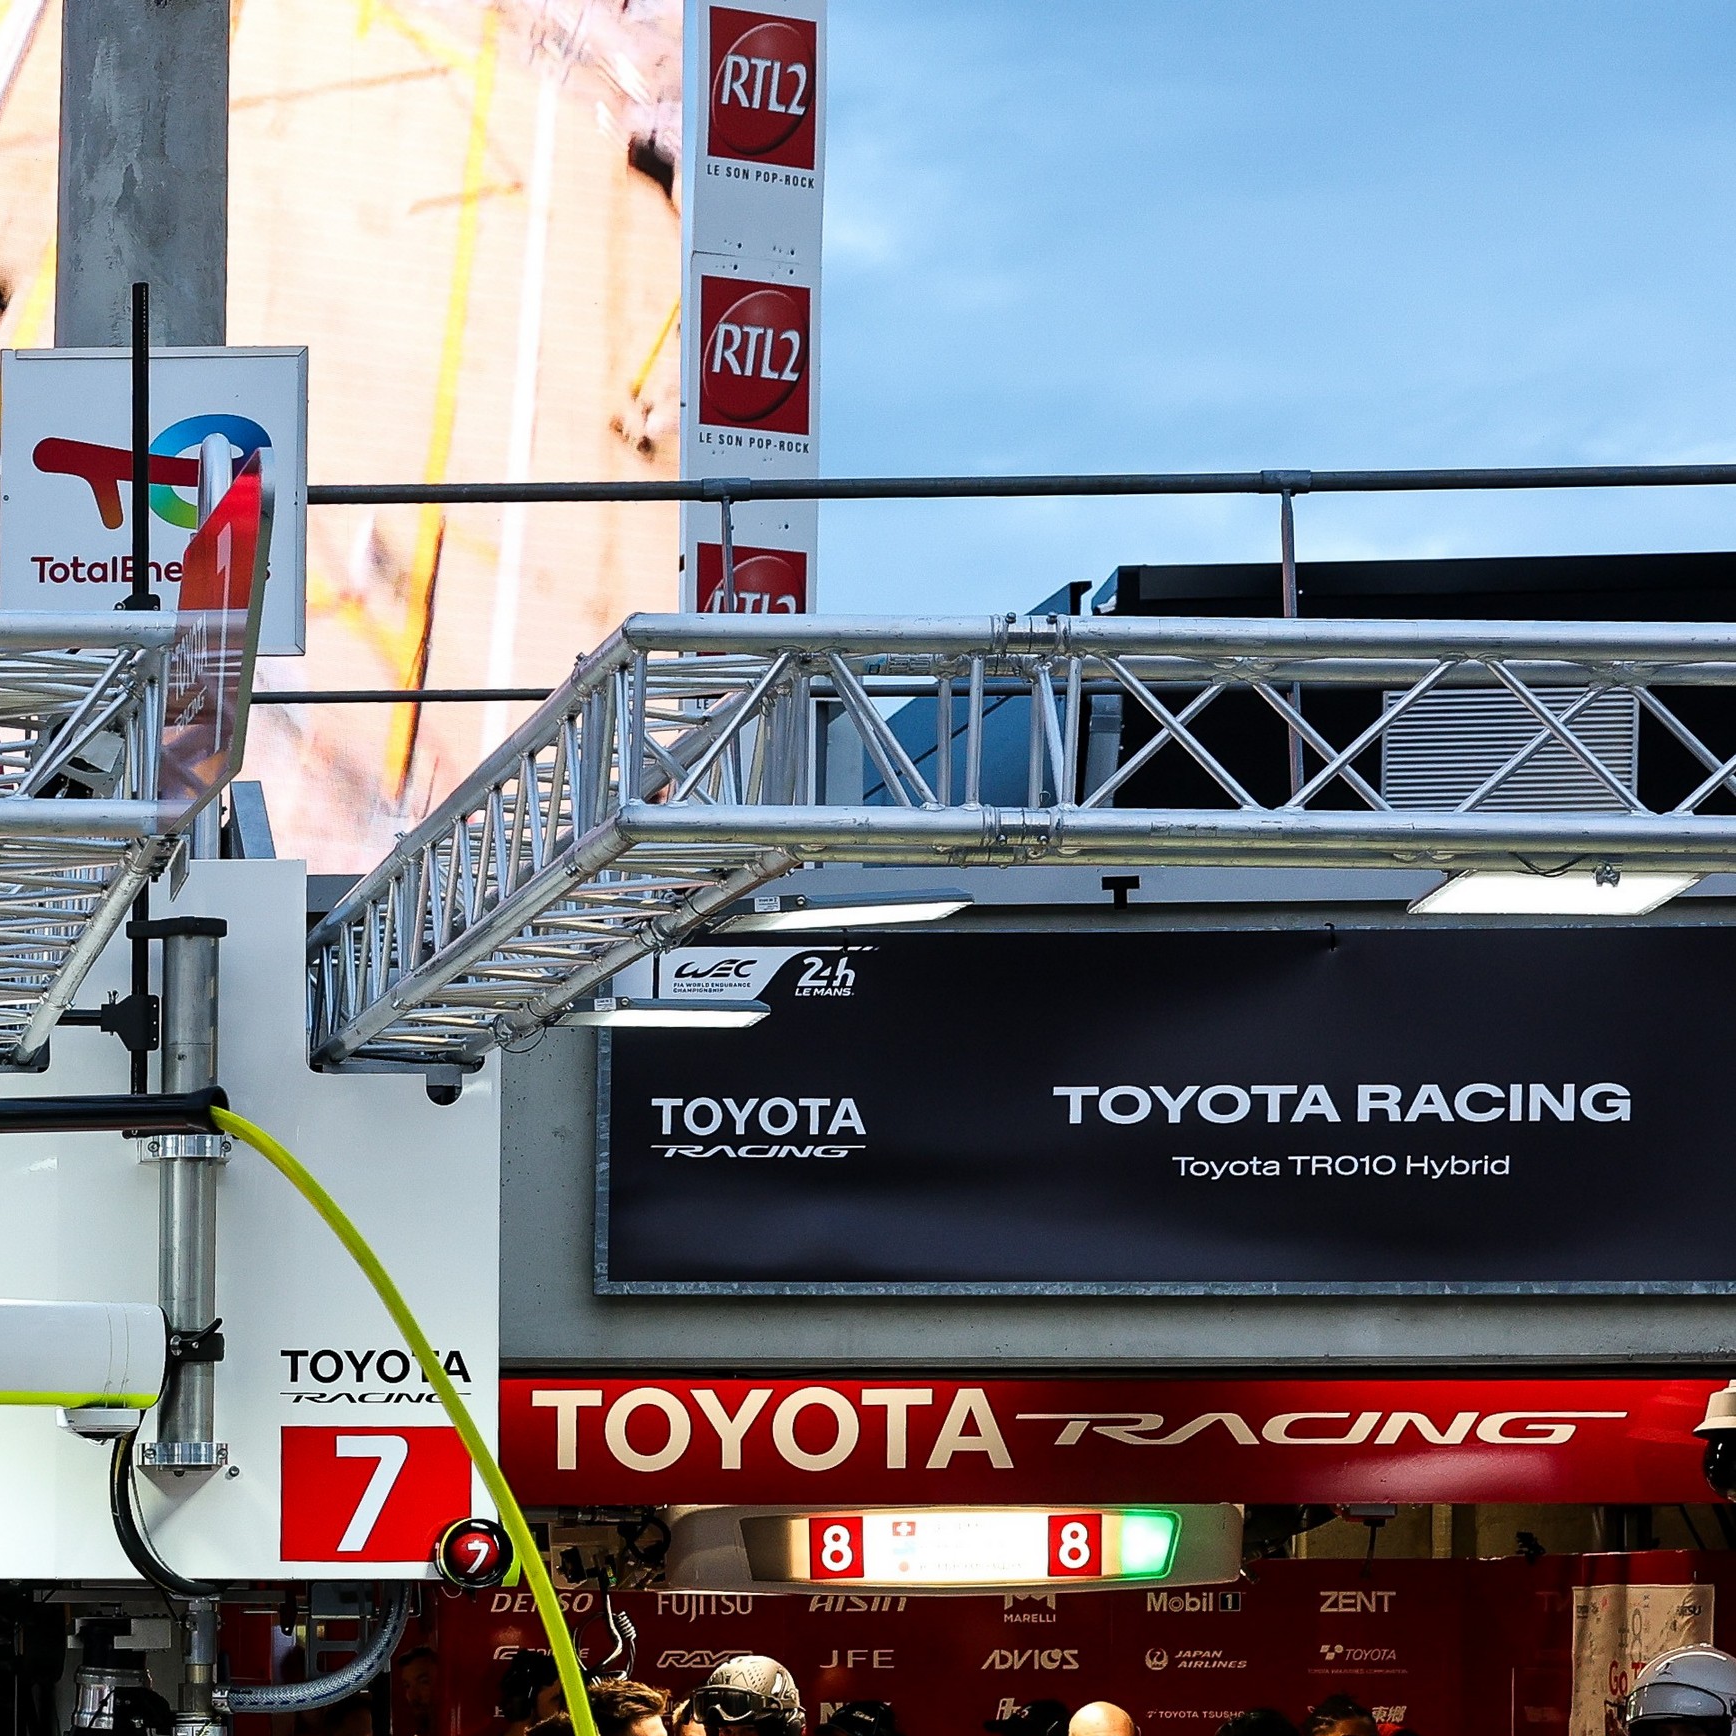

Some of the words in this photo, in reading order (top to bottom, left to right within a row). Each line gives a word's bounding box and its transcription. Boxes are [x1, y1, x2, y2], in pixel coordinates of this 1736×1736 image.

[721, 53, 807, 116] RTL2
[707, 164, 721, 177] LE
[725, 166, 749, 180] SON
[755, 171, 815, 189] POP-ROCK
[712, 321, 801, 383] RTL2
[674, 959, 757, 979] WEC
[797, 956, 856, 987] 24h
[794, 988, 811, 996] LE
[813, 988, 850, 996] MANS
[651, 1097, 866, 1137] TOYOTA
[1052, 1084, 1341, 1125] TOYOTA
[1355, 1082, 1632, 1125] RACING
[650, 1143, 866, 1159] RACING
[1172, 1154, 1281, 1180] Toyota
[1406, 1153, 1511, 1181] Hybrid
[280, 1349, 471, 1383] TOYOTA
[531, 1388, 1015, 1472] TOYOTA
[1015, 1411, 1628, 1447] RACING
[335, 1434, 408, 1552] 7
[466, 1541, 490, 1573] 7
[820, 1521, 853, 1570] 8
[1058, 1519, 1091, 1568] 8
[1146, 1592, 1213, 1612] Mobil
[1004, 1614, 1056, 1623] MARELLI
[1175, 1650, 1222, 1658] JAPAN
[1178, 1660, 1247, 1669] AIRLINES
[1345, 1649, 1397, 1661] TOYOTA
